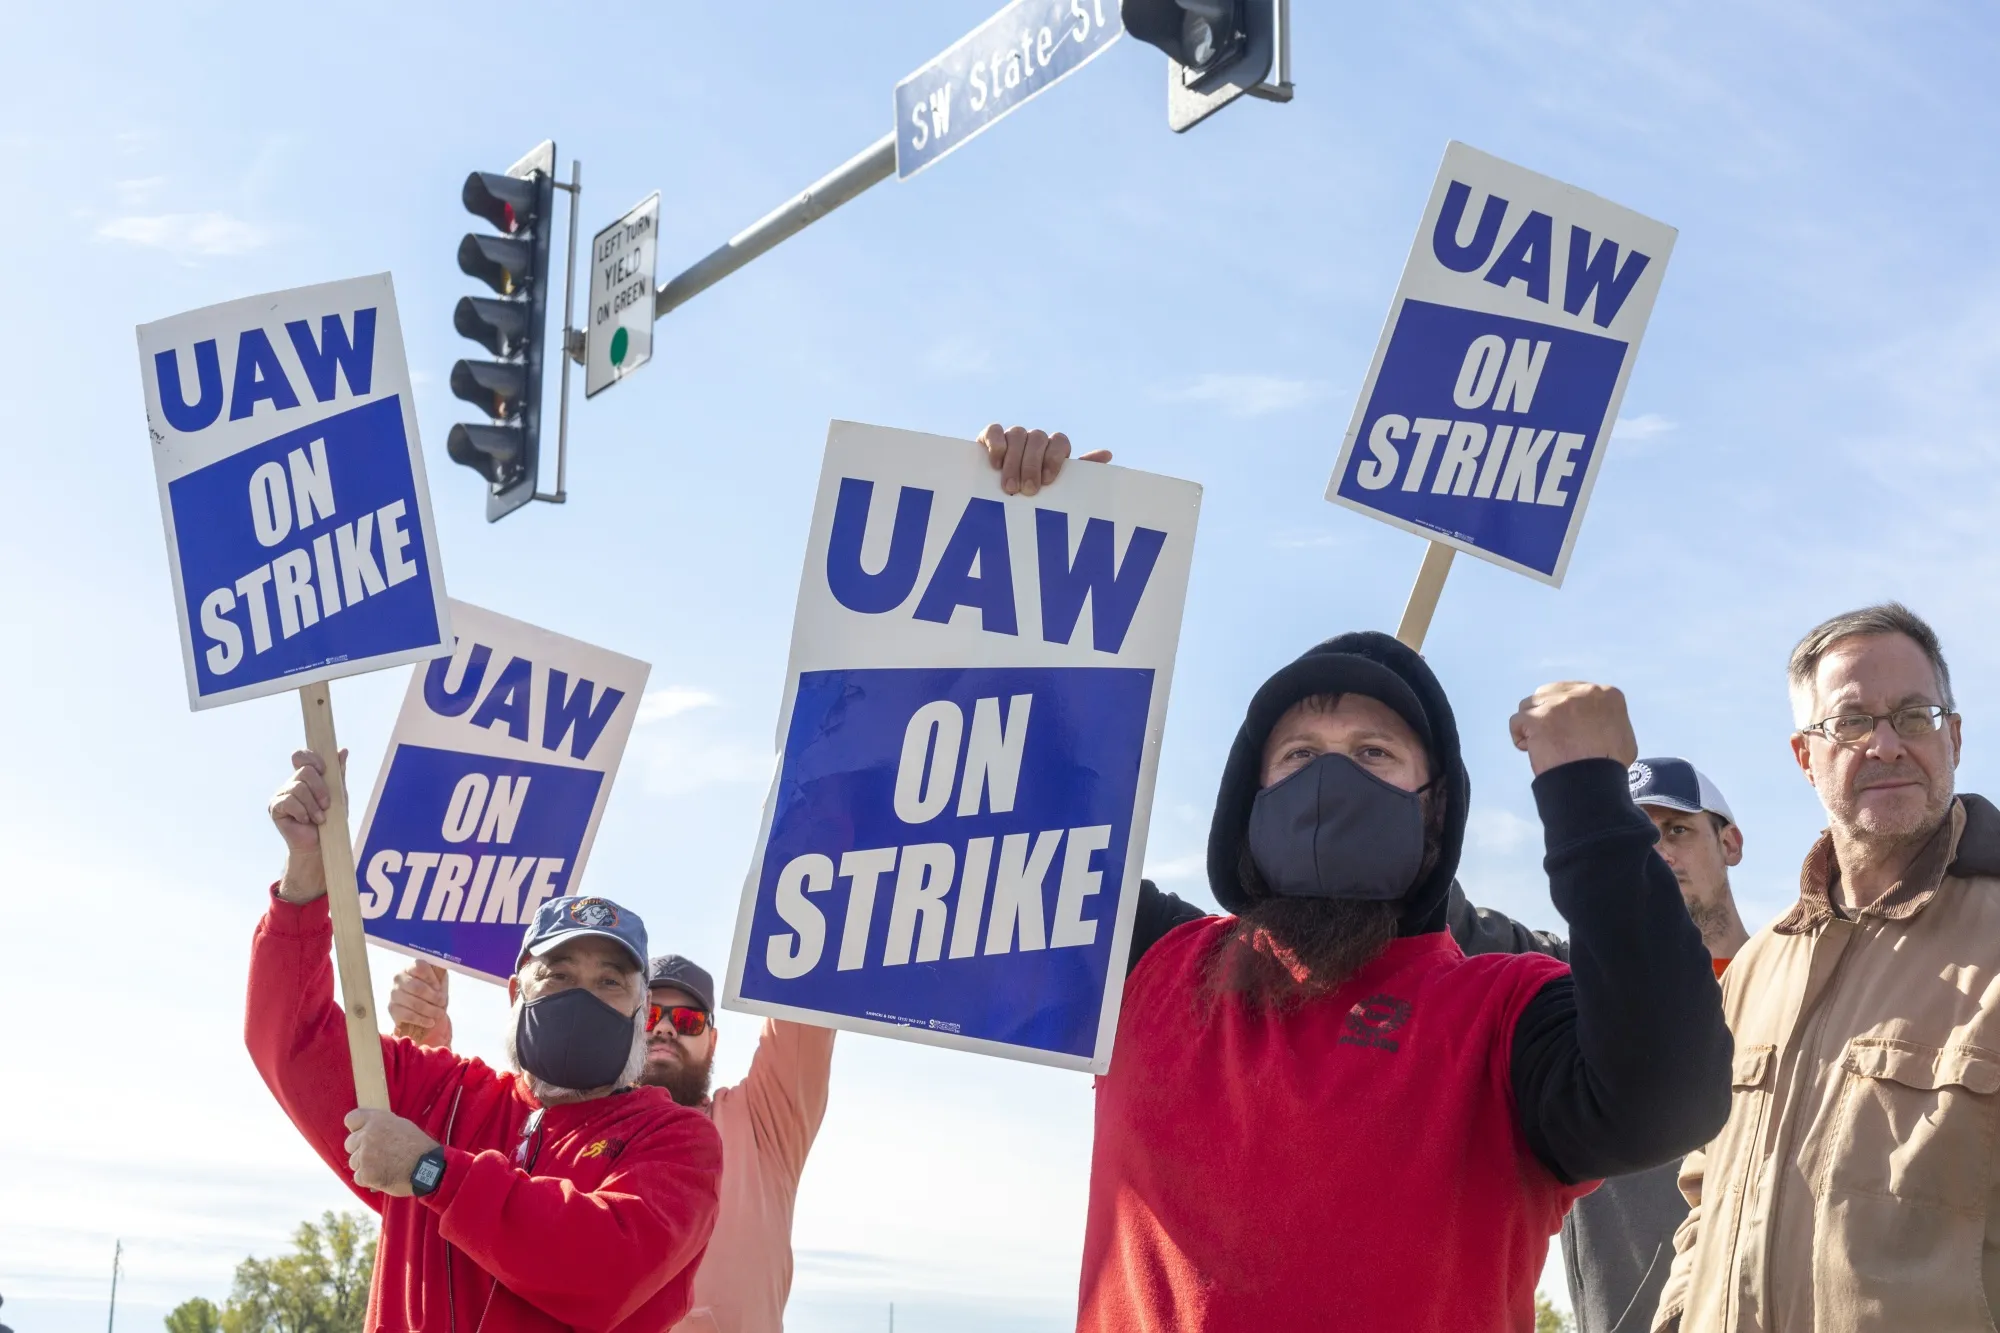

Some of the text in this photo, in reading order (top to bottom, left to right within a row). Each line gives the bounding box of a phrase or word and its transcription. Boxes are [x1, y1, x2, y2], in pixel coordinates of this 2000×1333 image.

[912, 81, 951, 150] SW
[970, 26, 1052, 111] State
[599, 214, 650, 263] LEFT TURN
[605, 248, 641, 291] YIELD
[1432, 179, 1652, 329] UAW
[597, 278, 646, 325] ON GREEN
[154, 307, 377, 433] UAW
[1453, 334, 1552, 414] ON
[249, 437, 336, 547] ON
[1356, 414, 1586, 507] STRIKE
[201, 498, 418, 676] STRIKE
[826, 477, 1168, 655] UAW
[423, 636, 625, 761] UAW
[441, 773, 531, 844] ON
[893, 693, 1033, 825] ON
[359, 849, 565, 925] STRIKE
[766, 824, 1112, 980] STRIKE
